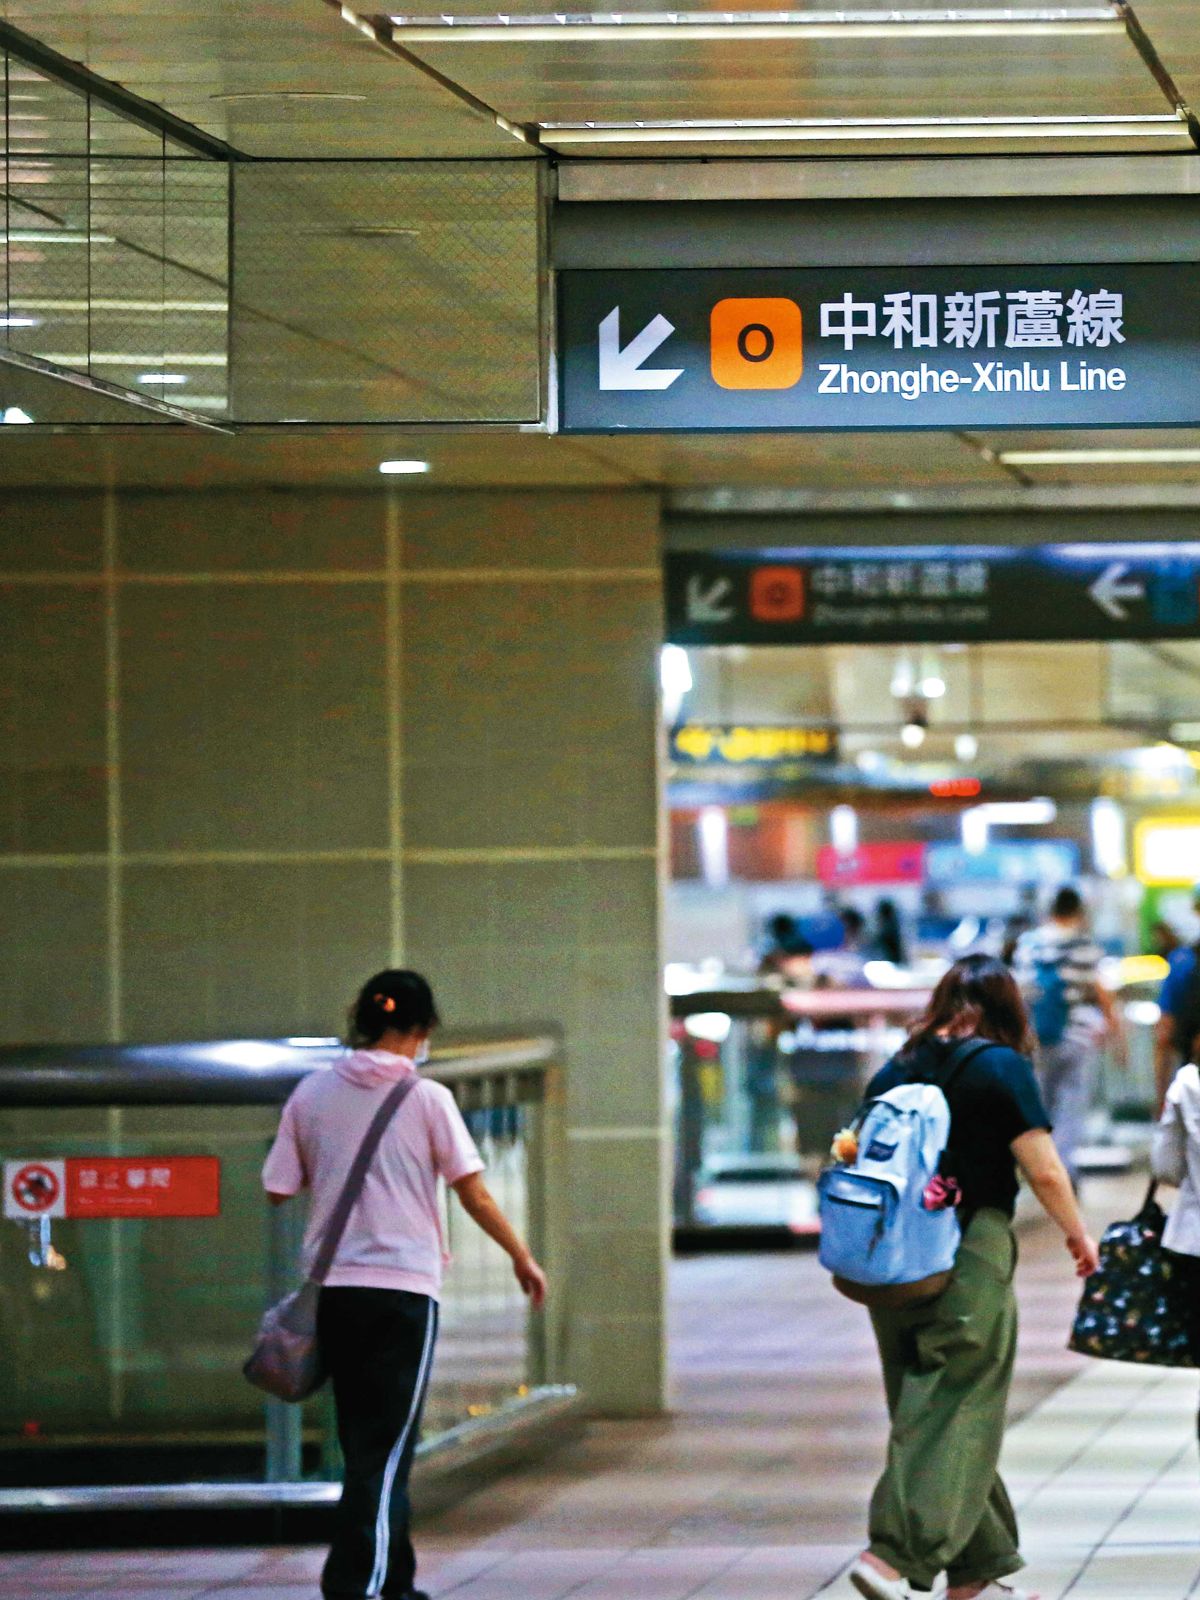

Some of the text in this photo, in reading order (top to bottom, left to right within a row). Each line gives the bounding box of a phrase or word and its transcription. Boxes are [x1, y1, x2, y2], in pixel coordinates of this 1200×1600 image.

[819, 288, 1127, 351] 中和新蘆線
[737, 323, 775, 363] O
[818, 359, 1127, 400] Zhonghe-Xinlu Line
